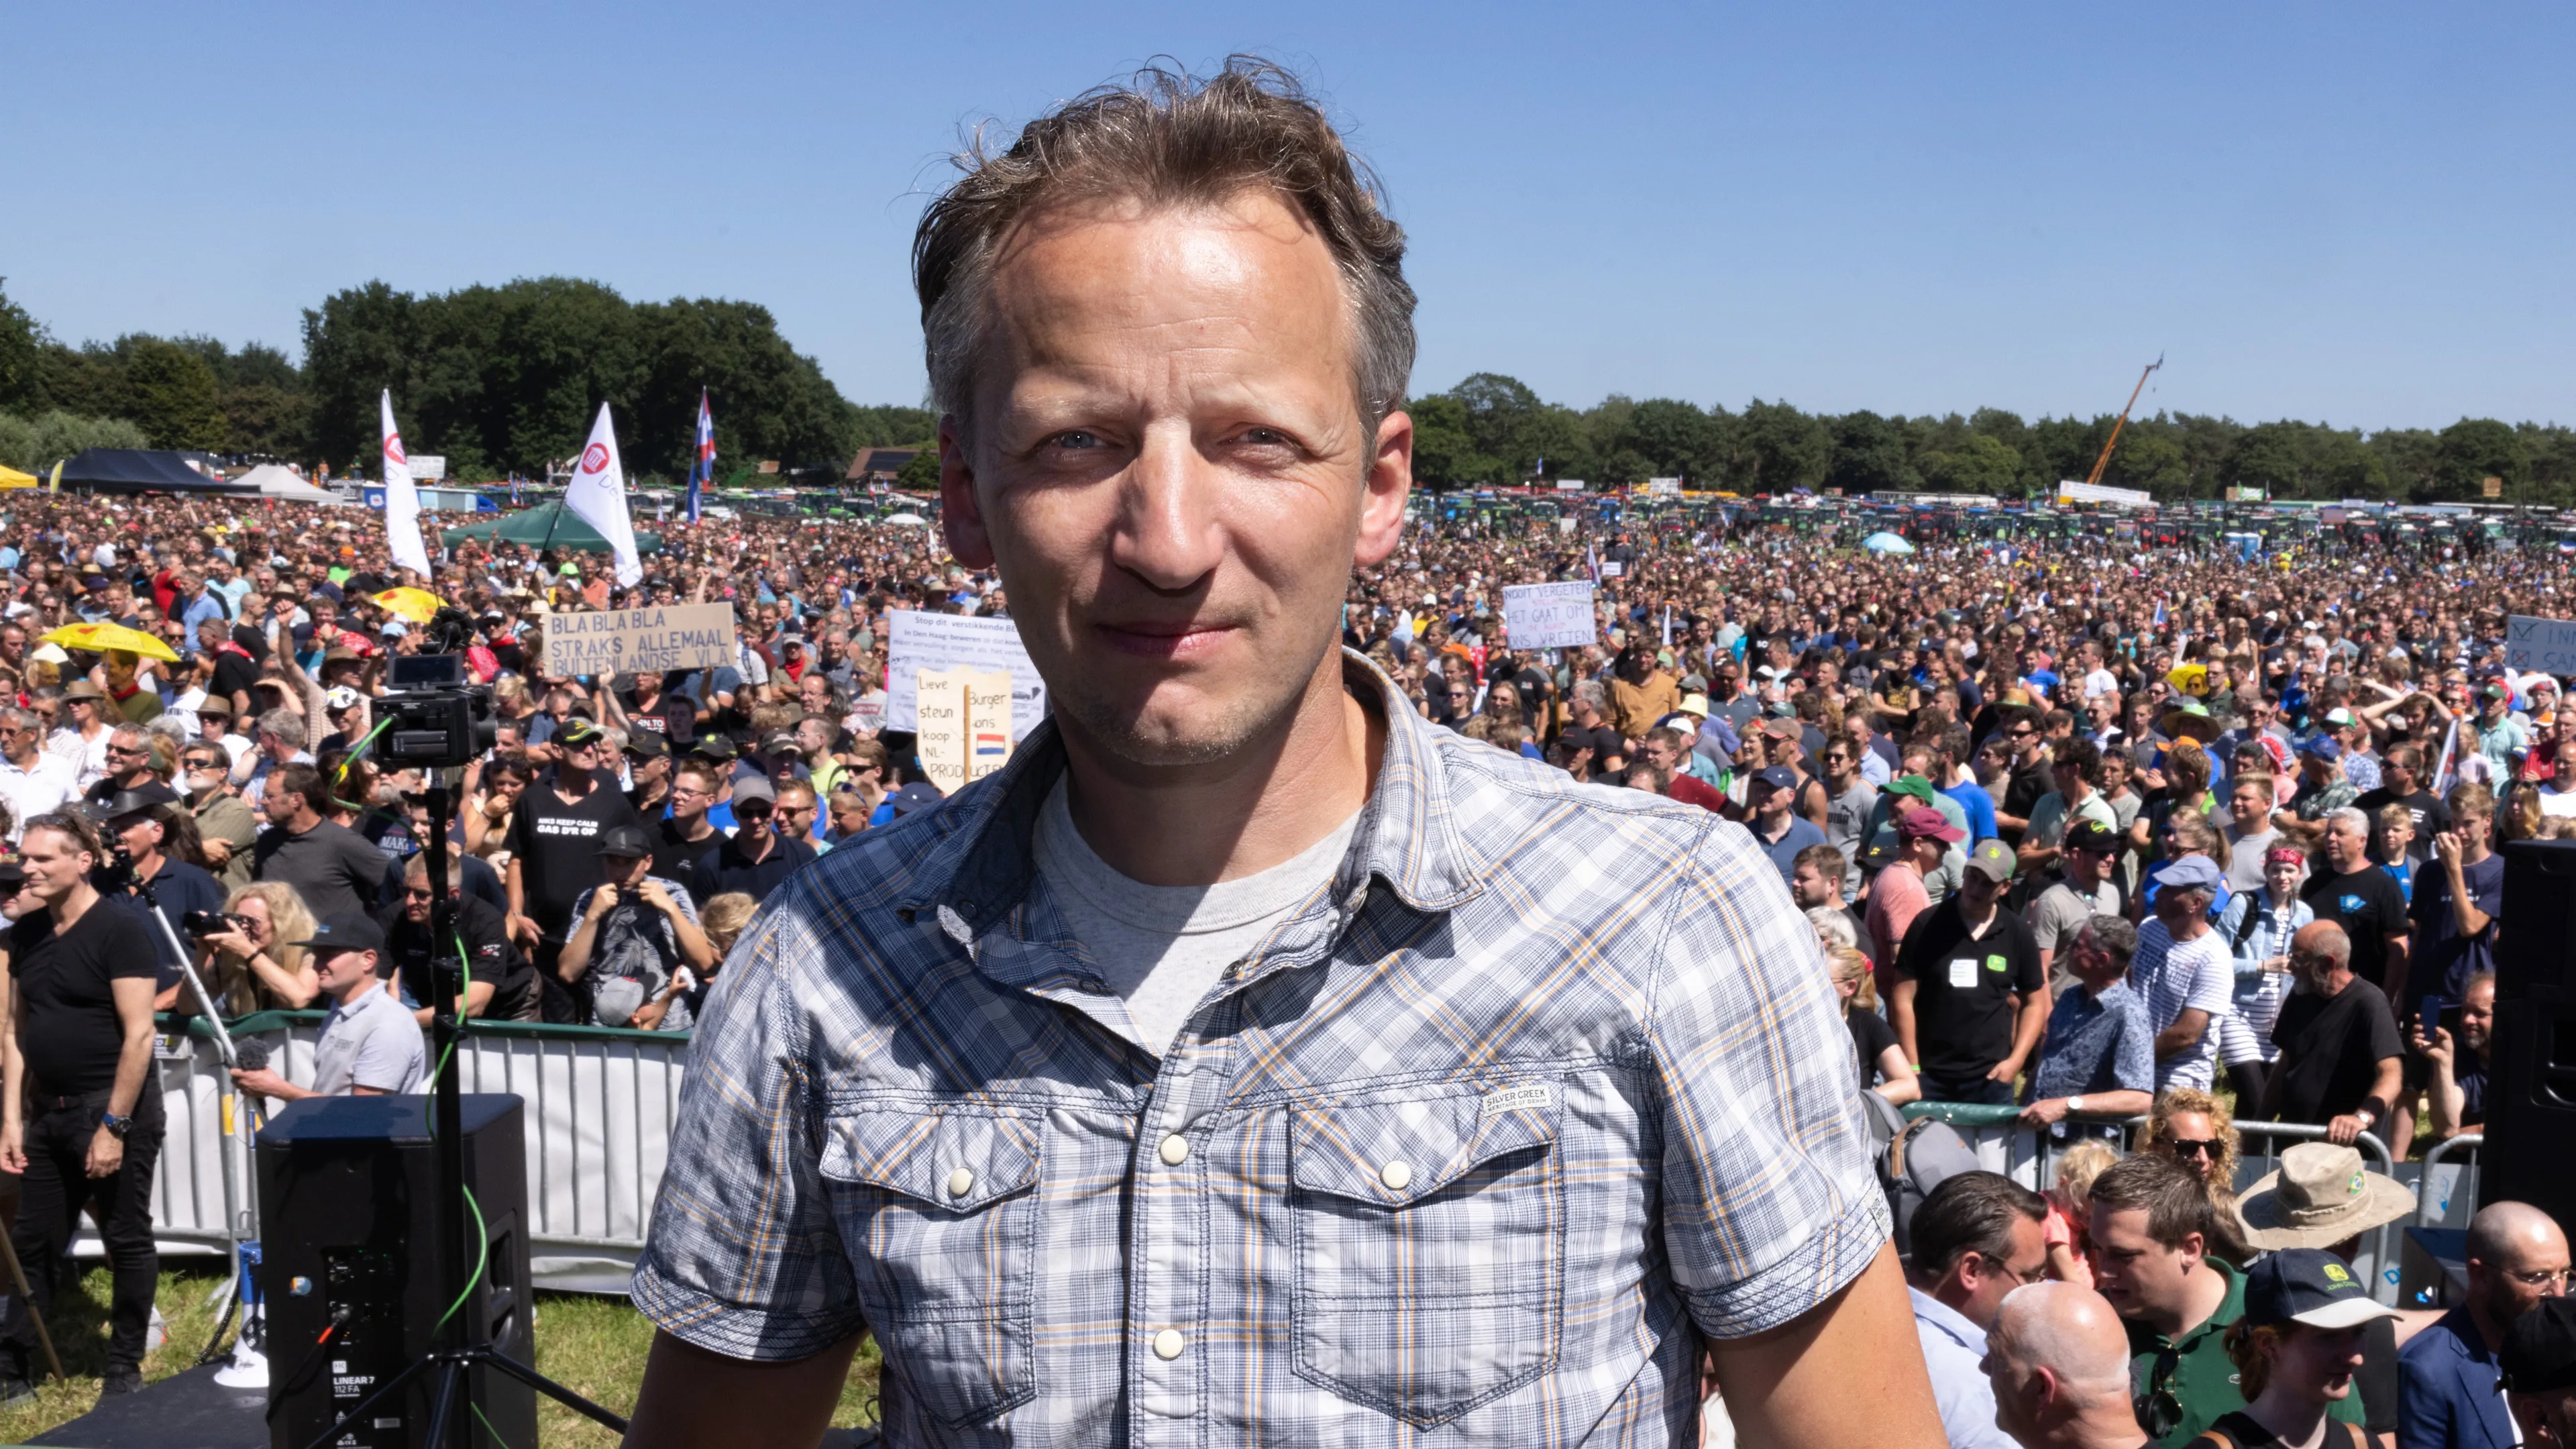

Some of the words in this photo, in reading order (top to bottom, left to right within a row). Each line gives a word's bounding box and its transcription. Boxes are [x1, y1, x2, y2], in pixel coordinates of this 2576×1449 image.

[1505, 588, 1532, 600] NOOIT
[1536, 583, 1590, 597] VERGETEN
[1507, 609, 1526, 624] HET
[1532, 606, 1559, 623] GAAT
[1566, 605, 1585, 619] OM
[551, 616, 588, 635] BLA
[592, 612, 627, 632] BLA
[632, 609, 665, 628] BLA
[915, 616, 934, 626] Stop
[936, 619, 947, 627] dit
[951, 620, 1004, 632] verstikkende
[1006, 625, 1019, 633] BE
[551, 637, 623, 658] STRAKS
[638, 629, 728, 652] ALLEMAAL
[950, 633, 981, 643] beweren
[1510, 635, 1532, 647] ONS
[553, 651, 682, 676] BUITENLANDSE
[696, 647, 729, 667] VLA
[918, 676, 949, 690] Lieve
[969, 692, 1007, 709] Burger
[920, 705, 953, 718] steun
[974, 718, 996, 729] ons
[922, 729, 950, 743] koop
[925, 746, 945, 758] NL-
[537, 825, 559, 835] GAS
[580, 827, 597, 836] OP
[576, 819, 598, 828] CALM
[1487, 1092, 1516, 1107] SILVER
[1517, 1089, 1546, 1099] CREEK
[1488, 1101, 1516, 1112] HERITAGE
[2326, 1282, 2345, 1291] JOHN
[333, 1377, 368, 1385] LINEAR
[369, 1376, 375, 1384] 7
[333, 1385, 347, 1393] 112
